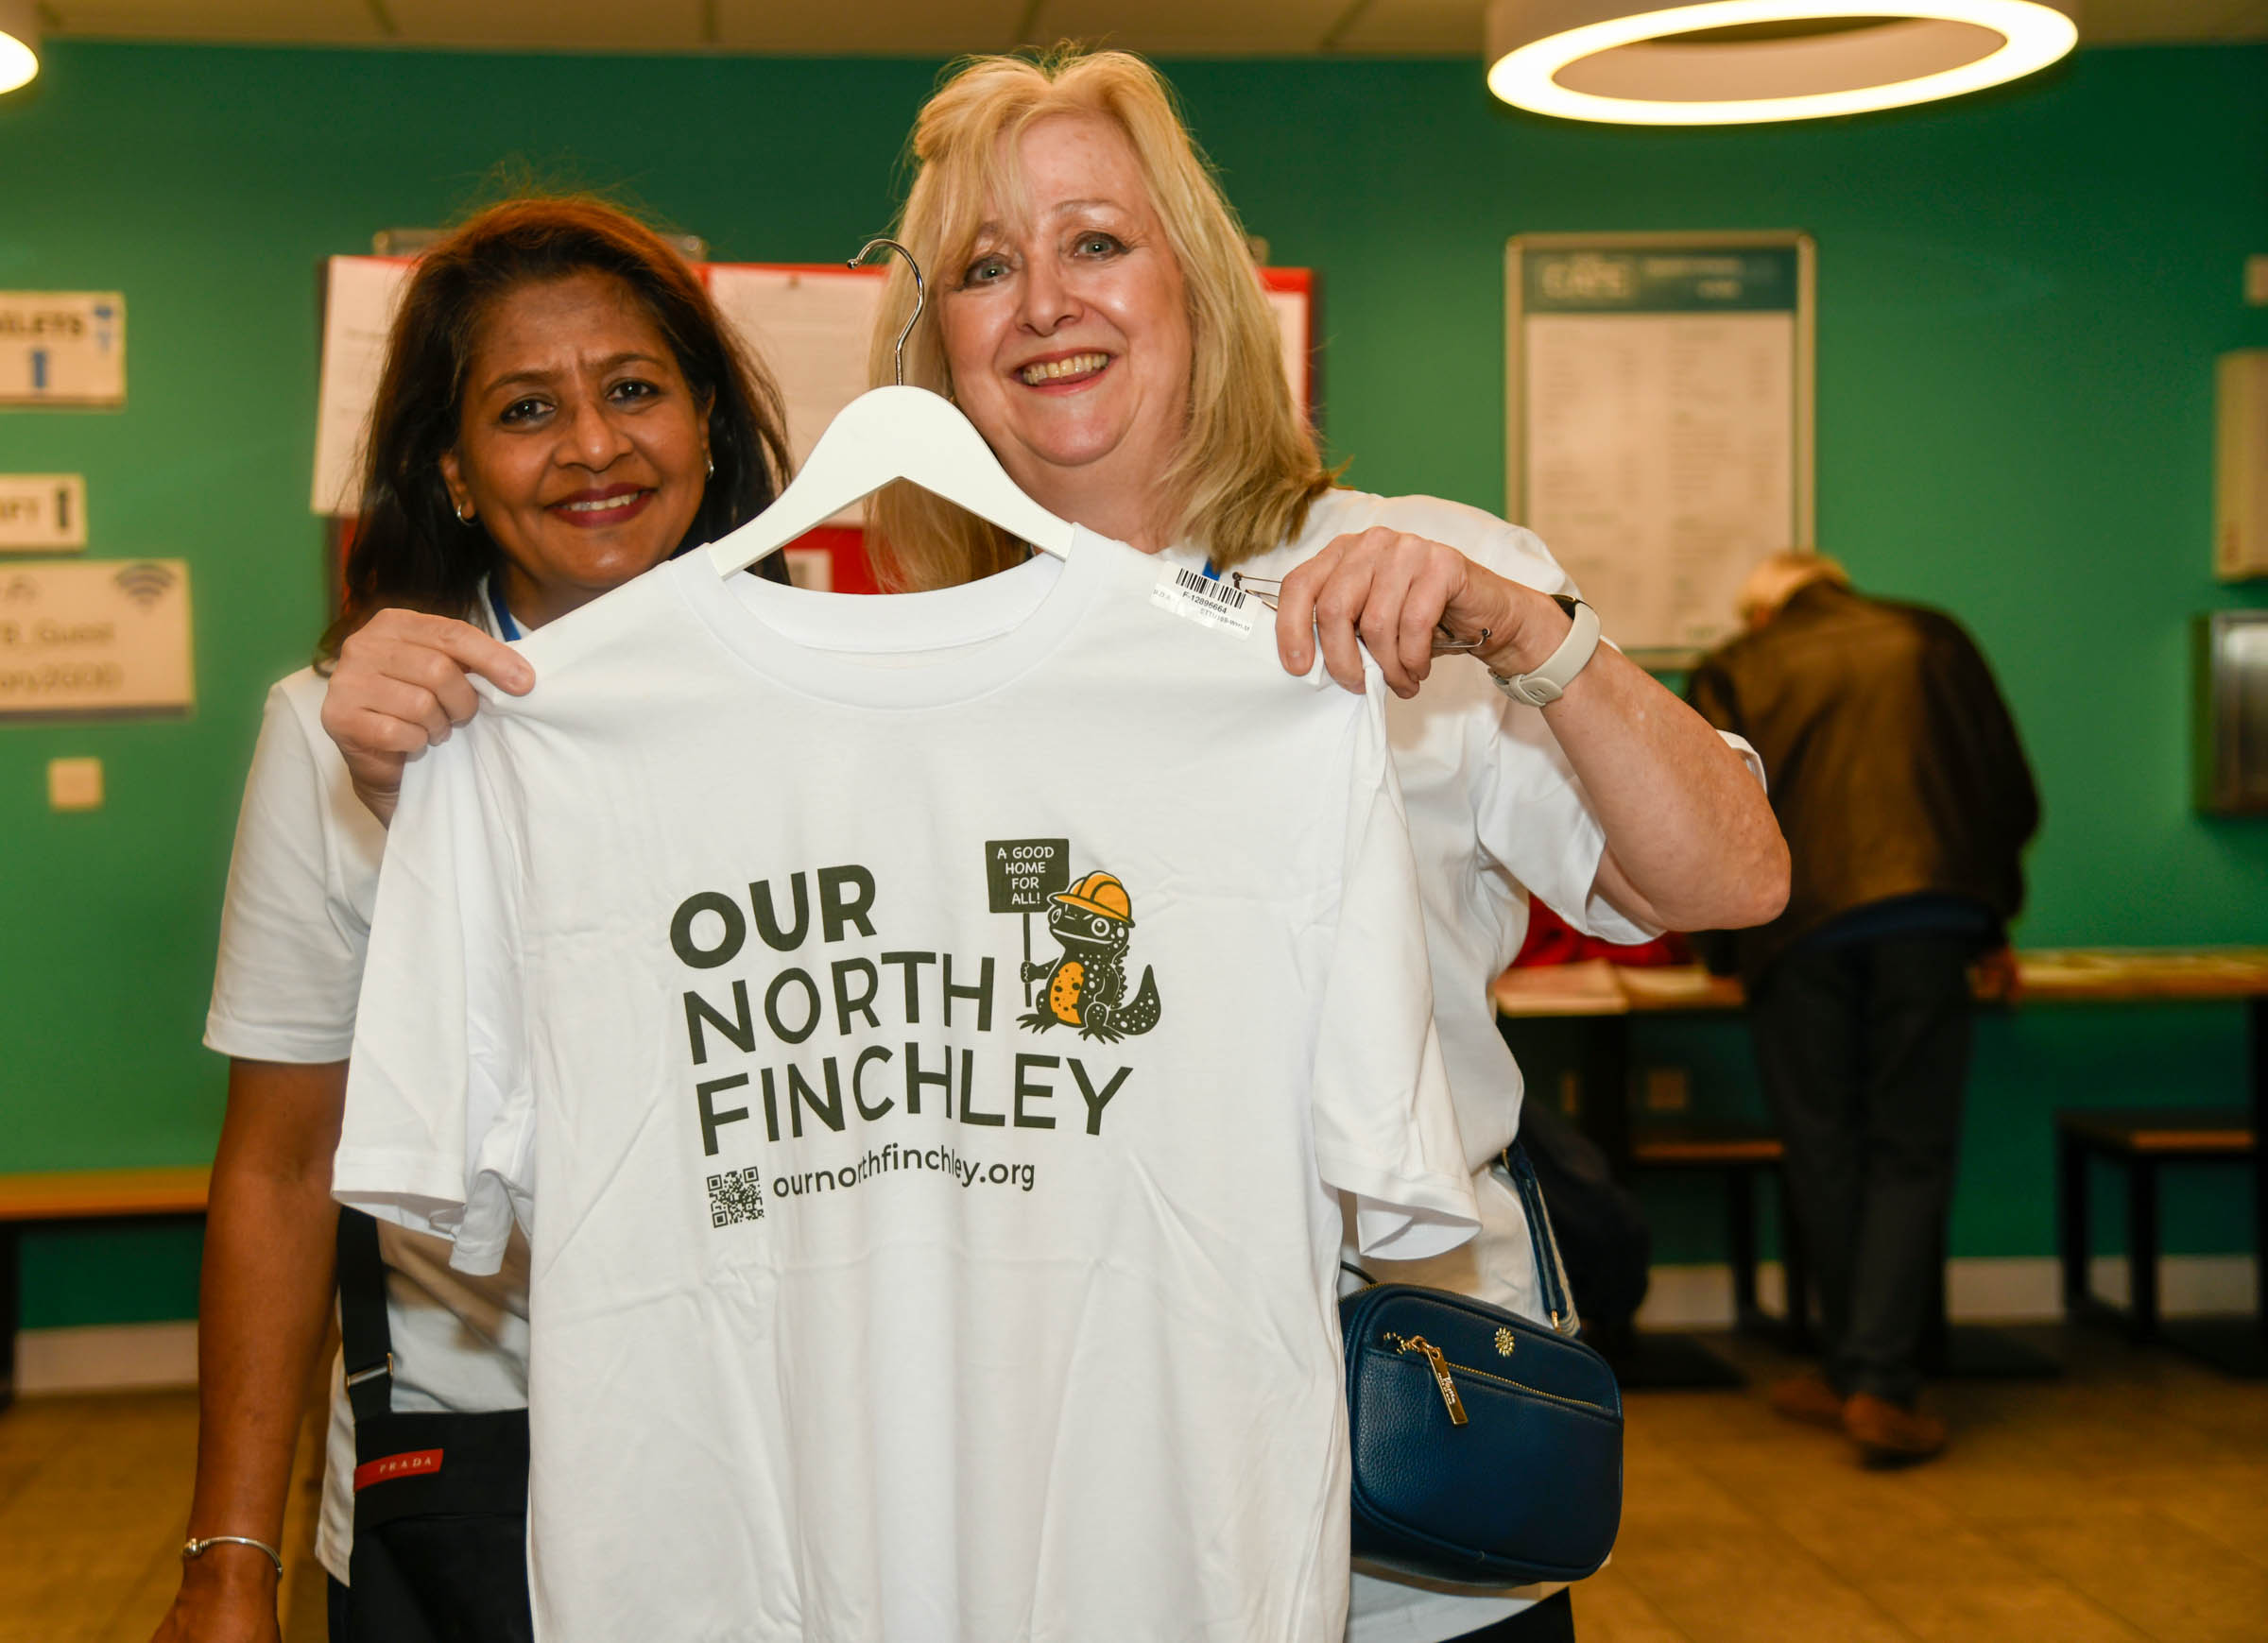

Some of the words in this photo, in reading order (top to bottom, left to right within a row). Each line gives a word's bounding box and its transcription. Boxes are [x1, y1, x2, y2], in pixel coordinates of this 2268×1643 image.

[997, 847, 1007, 860] A
[1012, 846, 1055, 859] GOOD
[1005, 861, 1046, 875] HOME
[1011, 877, 1040, 890] FOR
[1011, 892, 1040, 905] ALL!
[669, 864, 878, 969] OUR
[682, 950, 995, 1066] NORTH
[696, 1041, 1134, 1156] FINCHLEY
[773, 1142, 1036, 1198] ournorthfinchley.org
[380, 1457, 432, 1474] PRADA
